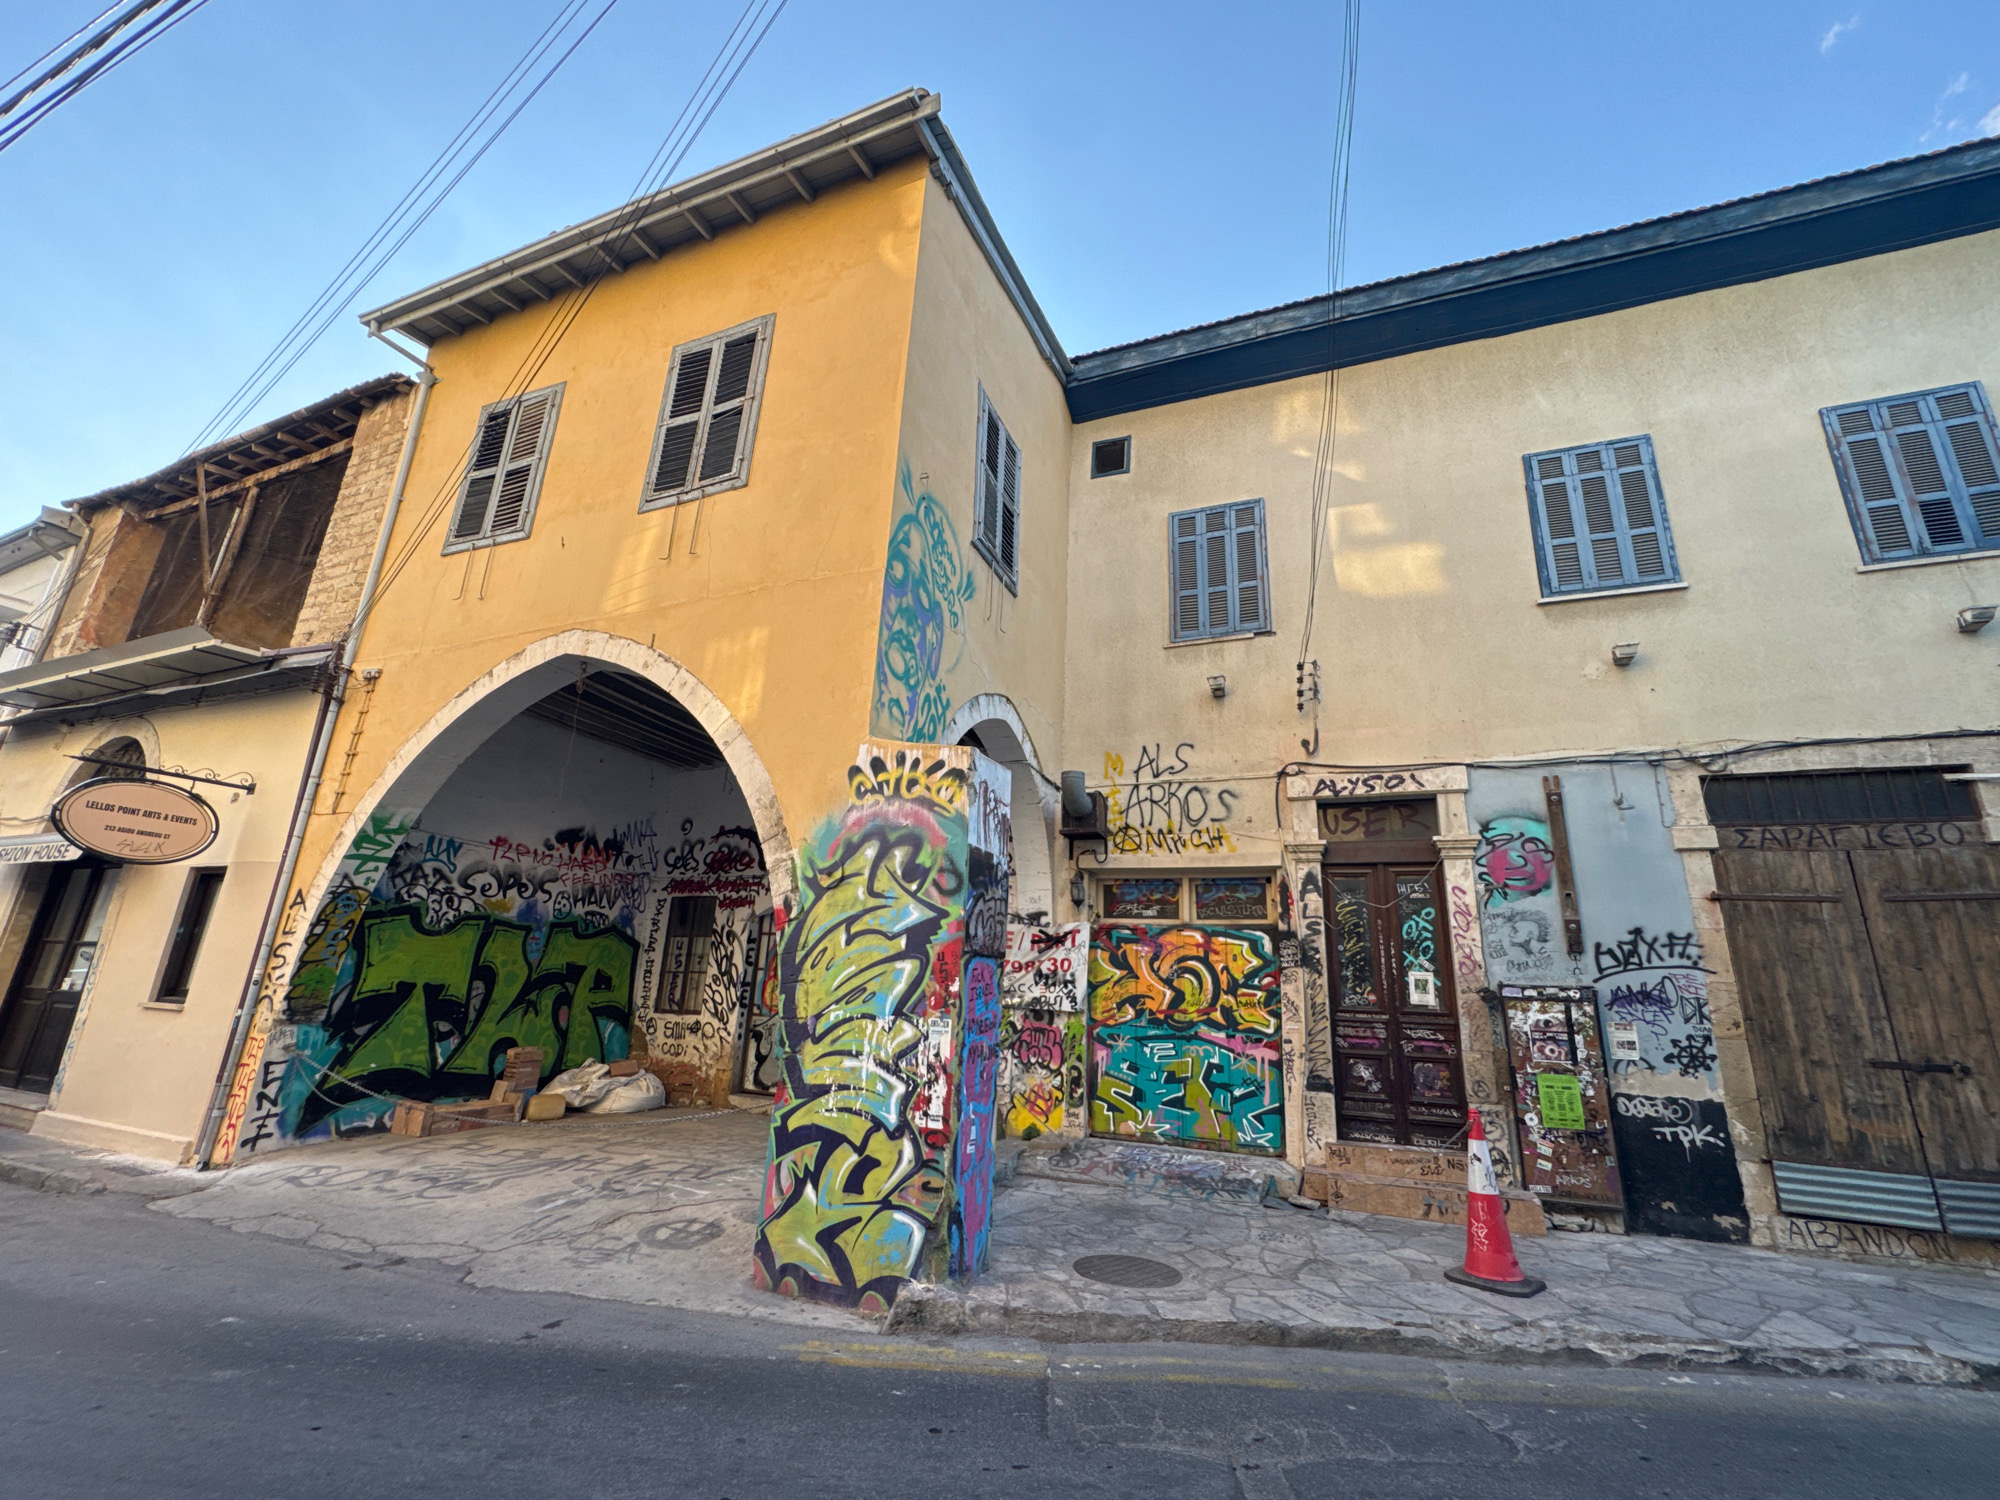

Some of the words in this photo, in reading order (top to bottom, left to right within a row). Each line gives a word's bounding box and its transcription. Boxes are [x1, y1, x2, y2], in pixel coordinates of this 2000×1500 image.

[1134, 743, 1194, 782] ALS
[85, 800, 115, 812] LELLOS
[117, 805, 141, 816] POINT
[142, 810, 162, 820] ARTS
[170, 814, 198, 826] EVENTS
[1119, 782, 1237, 832] ARKOS
[1322, 804, 1431, 838] USER
[32, 844, 71, 860] HOUSE
[533, 848, 553, 866] NO
[557, 852, 607, 873] HARD
[559, 871, 636, 888] FEELINGS
[1789, 1219, 1959, 1262] ABANDON
